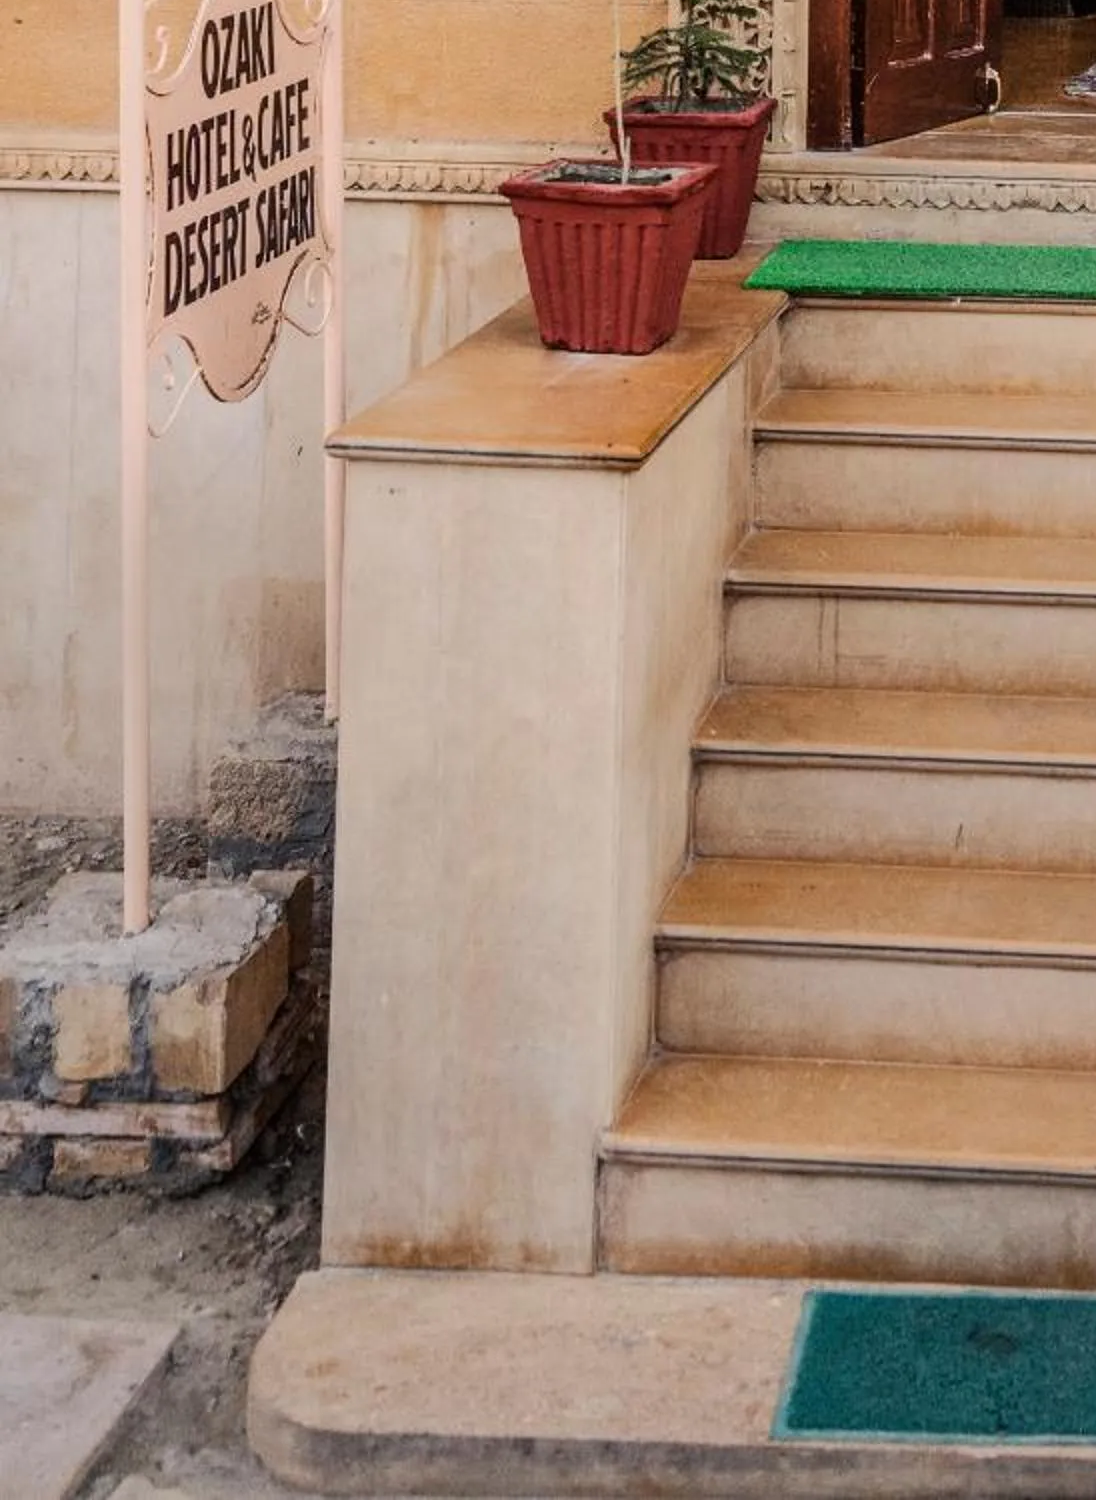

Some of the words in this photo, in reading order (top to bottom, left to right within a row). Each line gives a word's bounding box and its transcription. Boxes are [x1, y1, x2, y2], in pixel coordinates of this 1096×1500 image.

[201, 1, 275, 100] OZAKI
[166, 109, 241, 212] HOTEL
[257, 77, 311, 171] CAFE
[163, 196, 250, 318] DESERT
[254, 164, 317, 269] SAFARI
